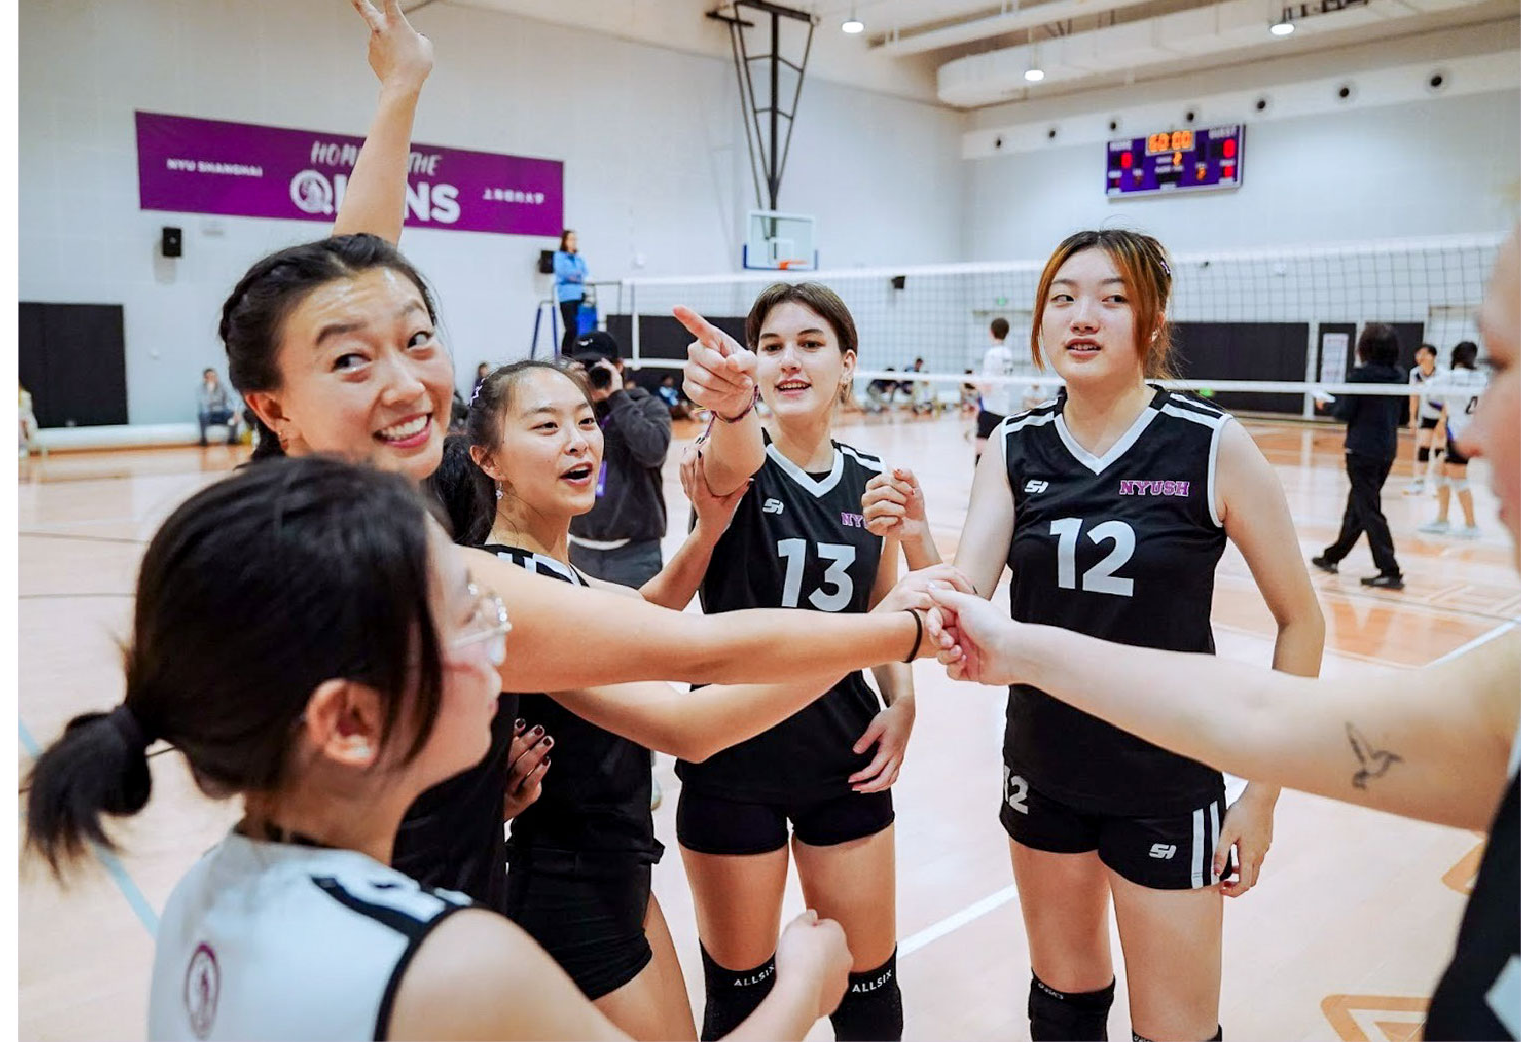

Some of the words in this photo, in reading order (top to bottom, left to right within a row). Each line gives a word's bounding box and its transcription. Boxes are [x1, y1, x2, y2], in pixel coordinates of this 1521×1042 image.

[310, 138, 358, 168] HOM
[290, 169, 461, 225] QINS
[1119, 480, 1190, 497] NYUSH
[1049, 517, 1137, 597] 12
[777, 537, 856, 612] 13
[734, 963, 775, 987] ALLSIX
[851, 969, 893, 993] ALLSIX
